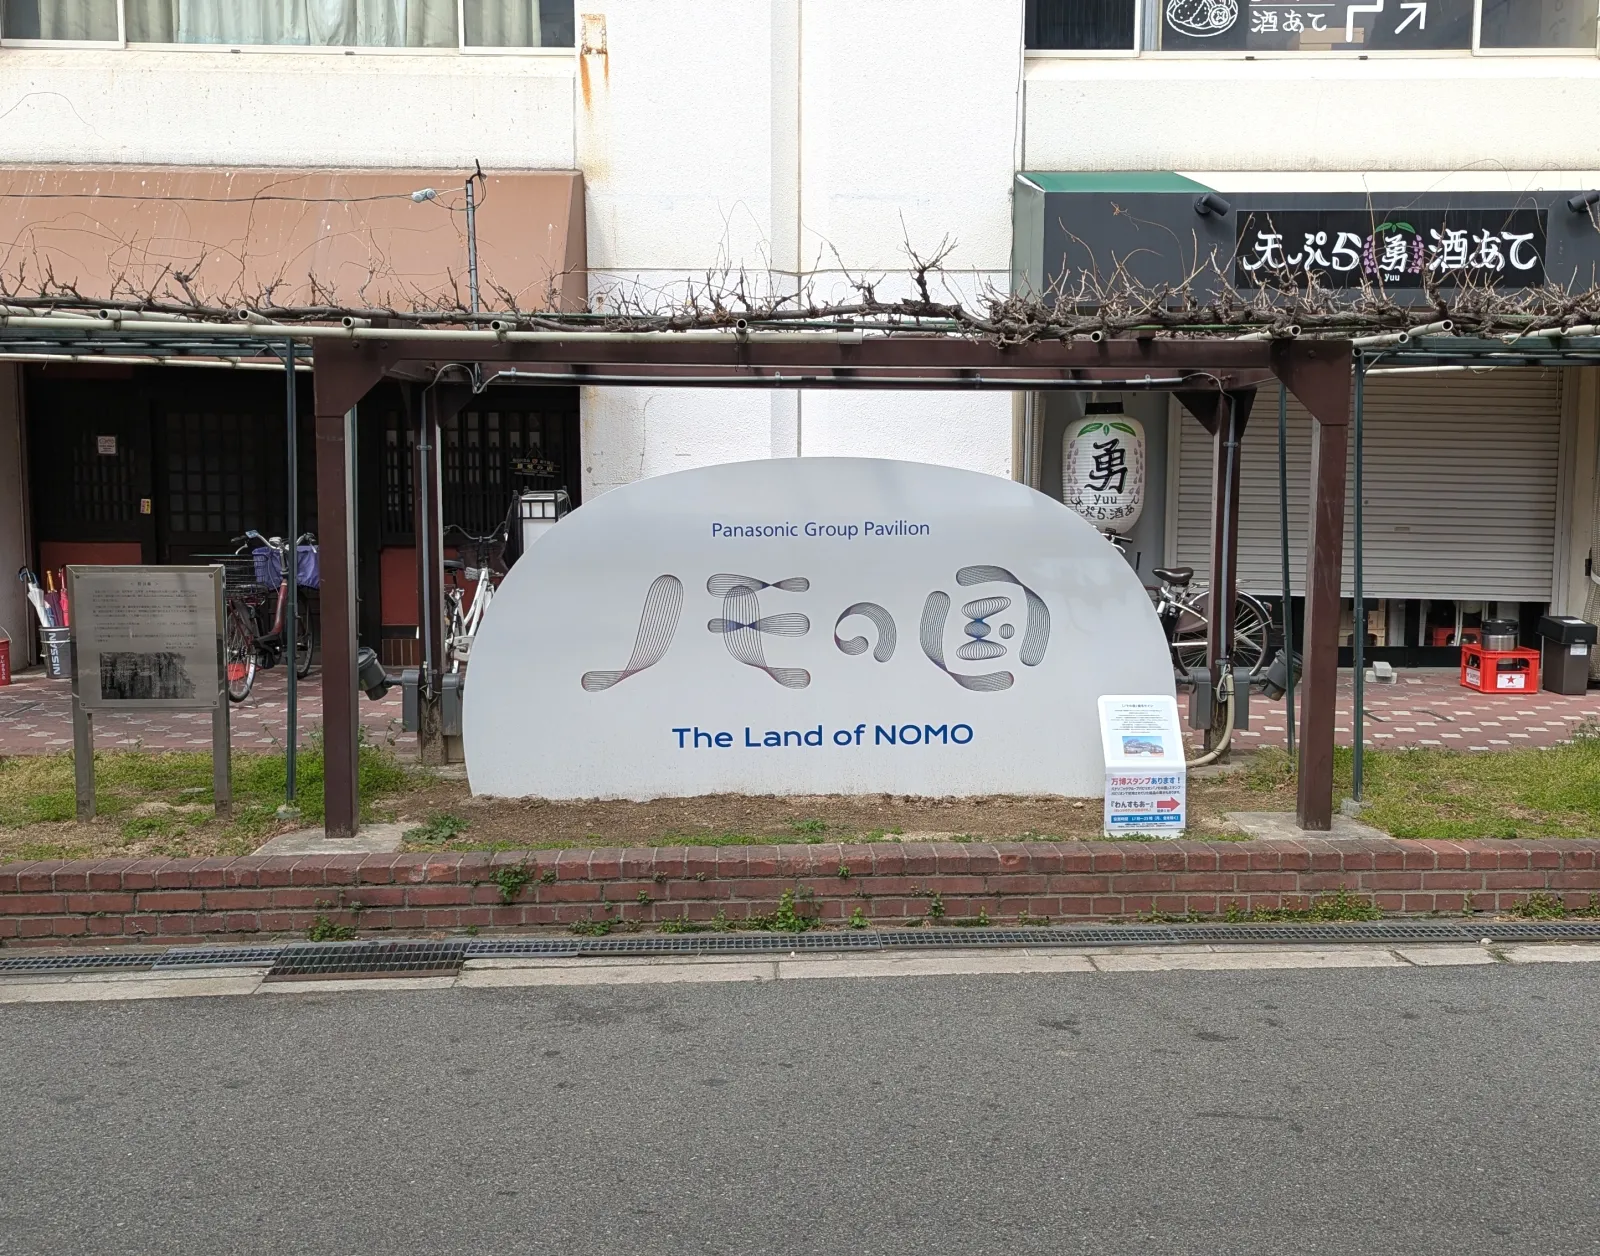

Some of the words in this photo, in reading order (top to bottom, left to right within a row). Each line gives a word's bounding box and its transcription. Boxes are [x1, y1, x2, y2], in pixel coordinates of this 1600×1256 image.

[1251, 10, 1327, 33] 酒あて
[1242, 230, 1362, 271] 天ぷら
[1379, 233, 1409, 272] 勇
[1428, 228, 1537, 272] 酒あて
[1384, 273, 1401, 282] yuu
[1084, 438, 1128, 494] 勇
[1093, 494, 1118, 505] yuu
[712, 522, 800, 538] Panasonic
[804, 522, 859, 540] Group
[863, 519, 931, 537] Pavilion
[581, 564, 1051, 692] ノモの国
[672, 727, 733, 749] The
[744, 727, 823, 748] Land
[832, 725, 866, 748] of
[874, 724, 974, 746] NOMO
[1111, 777, 1180, 785] 万博スタンプあります！
